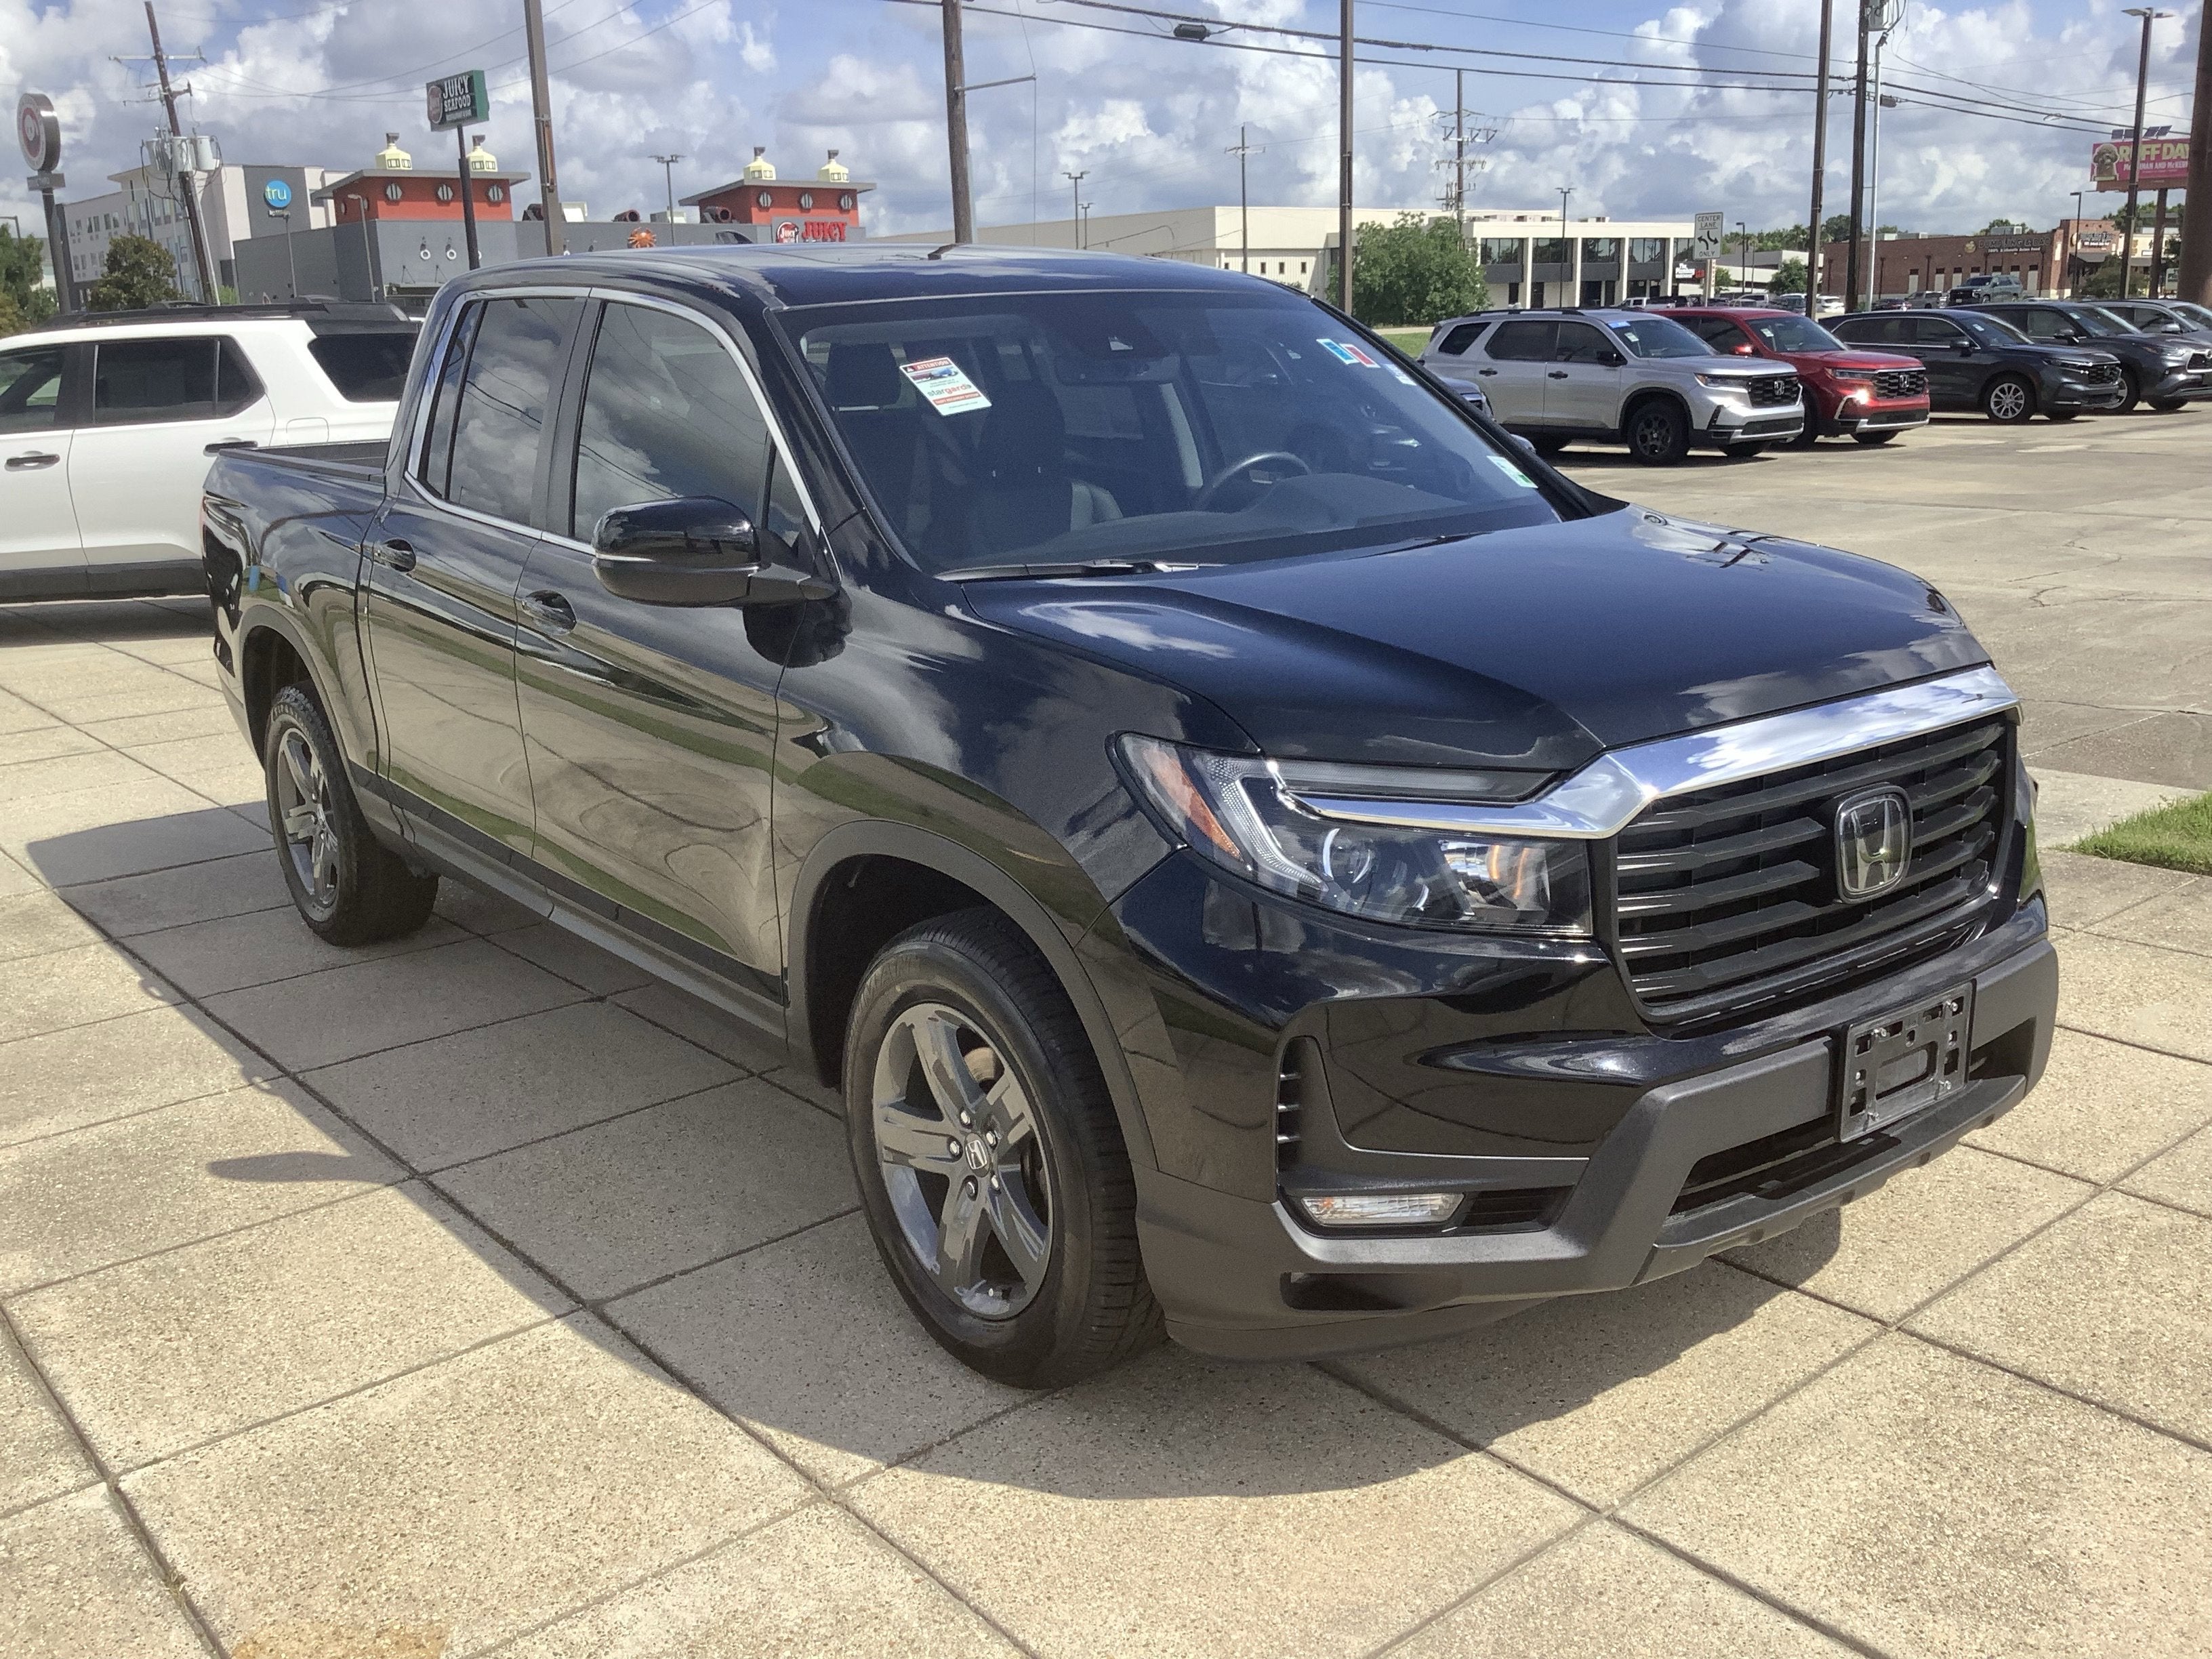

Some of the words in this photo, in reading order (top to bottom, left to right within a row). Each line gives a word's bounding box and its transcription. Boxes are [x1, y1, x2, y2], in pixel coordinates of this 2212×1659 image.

[443, 75, 470, 99] JUICY
[444, 94, 471, 112] SEAFOOD
[2118, 143, 2162, 161] RFF
[265, 185, 287, 200] tru
[802, 222, 846, 240] JUICY
[917, 359, 950, 370] ATTENTION
